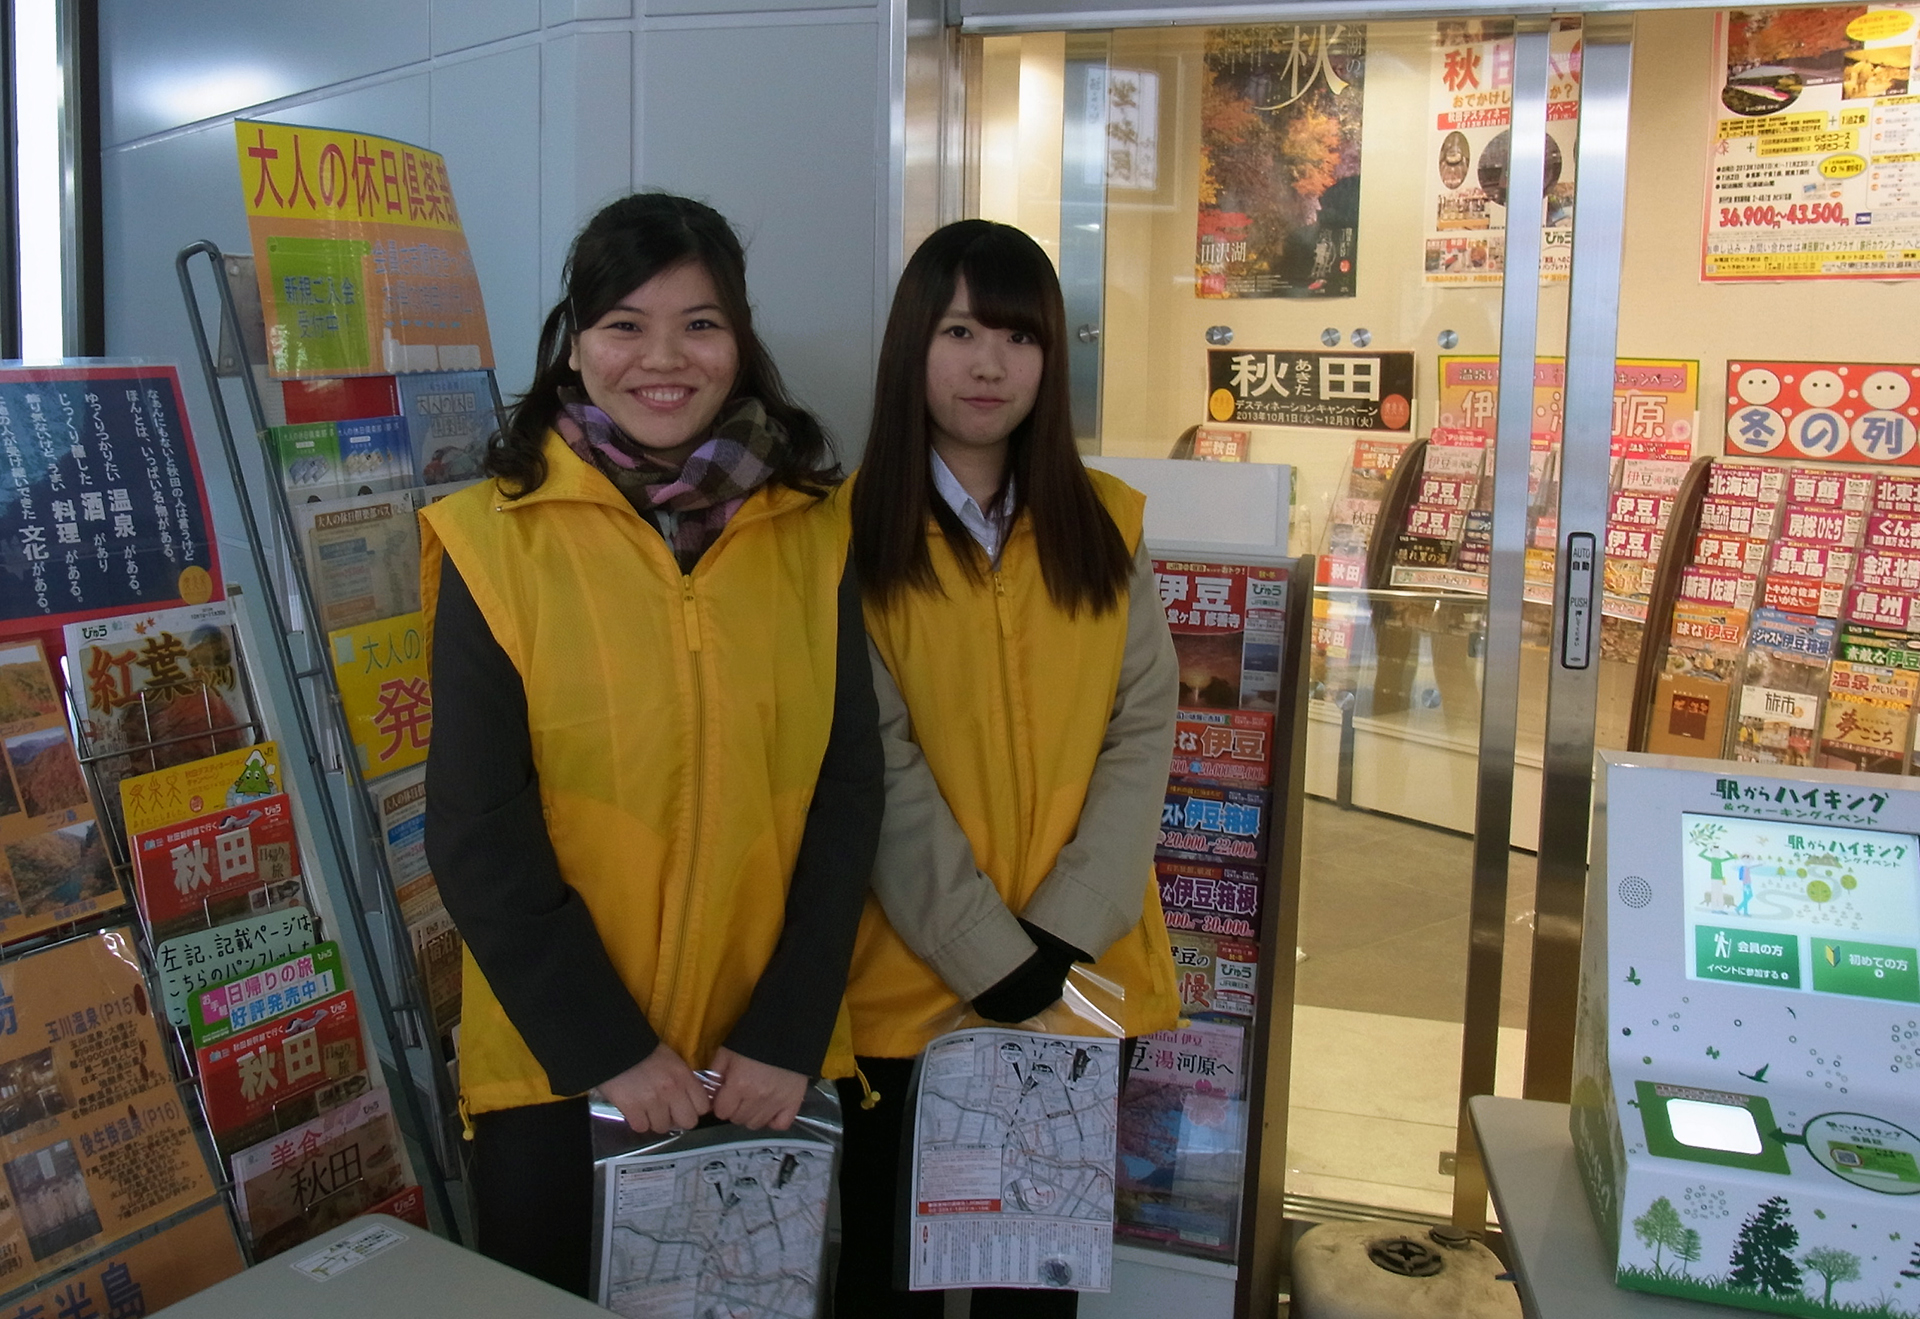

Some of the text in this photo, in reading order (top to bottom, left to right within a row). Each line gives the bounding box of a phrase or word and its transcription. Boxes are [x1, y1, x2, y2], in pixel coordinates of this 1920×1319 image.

[1250, 24, 1350, 111] 秋
[1200, 242, 1247, 264] 田沢湖
[1613, 371, 1684, 389] キャンペーン
[1235, 399, 1379, 416] デスティネーションキャンペーン
[1708, 475, 1760, 498] 北海道
[107, 488, 137, 538] 温泉
[1616, 497, 1655, 517] 伊豆
[51, 499, 82, 544] 料理
[80, 491, 106, 522] 酒
[93, 533, 109, 572] があり
[18, 525, 50, 562] 文化
[1608, 530, 1646, 550] 伊豆
[1700, 538, 1740, 560] 伊豆
[1572, 548, 1591, 559] AUTO
[1572, 561, 1590, 571] 自動
[1863, 555, 1892, 576] 金沢
[1252, 582, 1282, 597] びゅう
[1570, 597, 1589, 608] PUSH
[1856, 591, 1904, 617] 信州
[82, 624, 108, 640] びゅう
[1676, 621, 1739, 644] 味な伊豆
[1176, 726, 1266, 762] な伊豆
[1715, 778, 1890, 813] 駅からハイキング
[1787, 835, 1909, 861] 駅からハイキング
[169, 827, 255, 895] 秋田
[1160, 874, 1258, 917] な伊豆・箱根
[1737, 941, 1784, 957] 会員の方
[1220, 963, 1252, 979] びゅう
[1706, 964, 1780, 981] イベントに参加する
[1848, 953, 1909, 972] 初めての方
[227, 956, 316, 1006] 日帰りの旅
[1178, 972, 1211, 1009] 慢
[230, 973, 335, 1030] 好評発売中！
[235, 1027, 322, 1102] 秋田
[270, 1129, 324, 1181] 美食
[290, 1143, 364, 1208] 秋田
